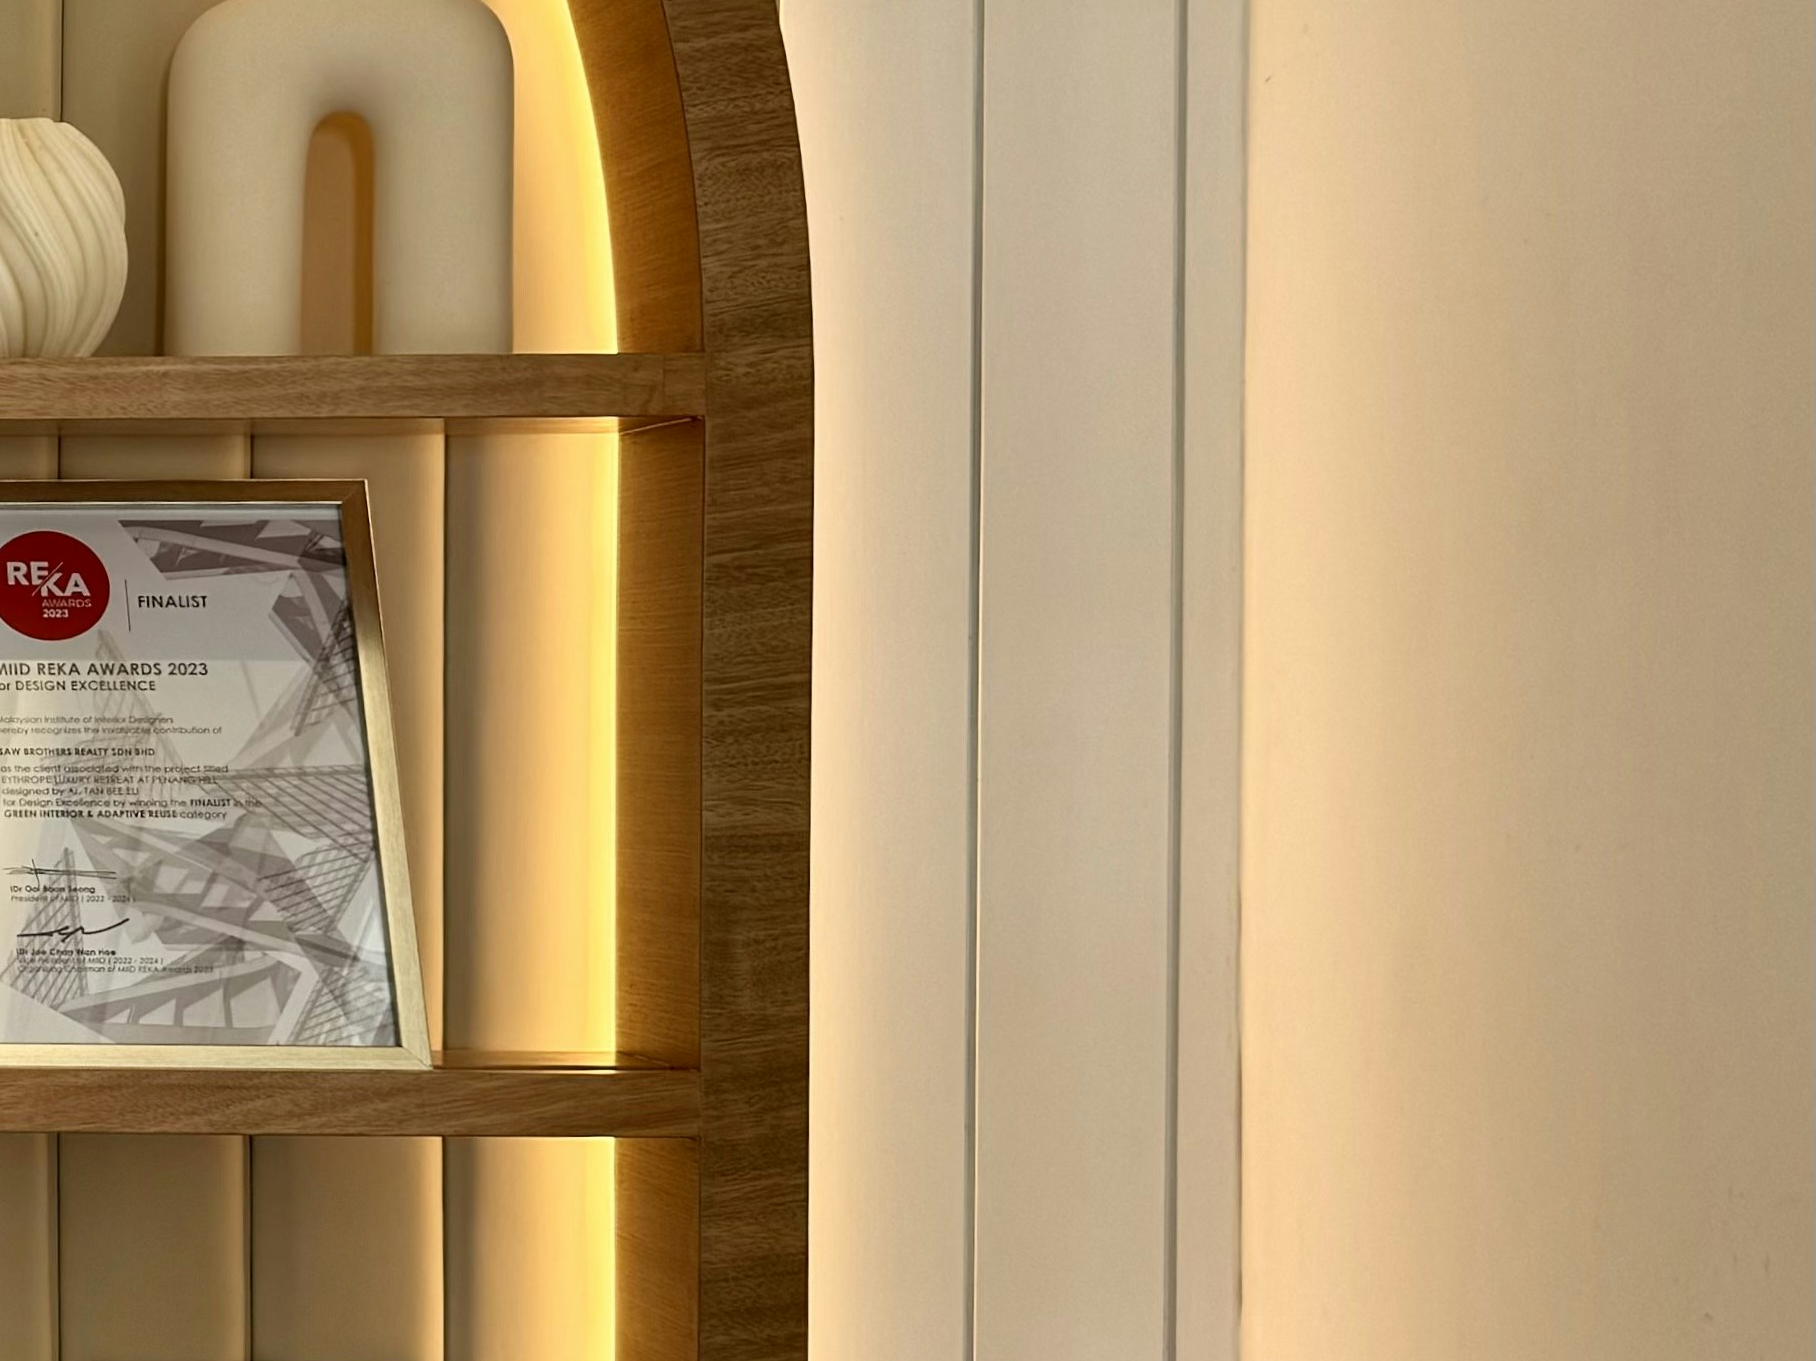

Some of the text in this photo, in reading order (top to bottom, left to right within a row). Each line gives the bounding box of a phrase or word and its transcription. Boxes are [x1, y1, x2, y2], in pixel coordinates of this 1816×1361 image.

[42, 599, 92, 608] AWARDS
[137, 595, 208, 609] FINALIST
[42, 608, 69, 618] 2023
[36, 663, 81, 676] REKA
[87, 663, 163, 676] AWARDS
[168, 663, 209, 676] 2023
[15, 681, 66, 692] DESIGN
[71, 680, 156, 692] EXCELLENCE
[44, 716, 80, 724] Institute
[213, 726, 222, 734] of
[24, 748, 72, 756] BROTHERS
[75, 748, 108, 756] REALTY
[112, 748, 132, 756] SDN
[135, 748, 155, 756] BHD
[14, 765, 31, 773] the
[33, 765, 61, 773] client
[121, 765, 142, 773] with
[145, 765, 161, 773] the
[164, 765, 201, 775] project
[137, 776, 149, 784] AT
[2, 787, 49, 796] designed
[52, 787, 64, 796] by
[3, 799, 16, 807] for
[19, 799, 53, 808] Design
[113, 799, 125, 808] by
[4, 810, 37, 818] GREEN
[40, 810, 84, 818] INTERIOR
[97, 810, 146, 818] ADAPTIVE
[179, 810, 226, 819] category
